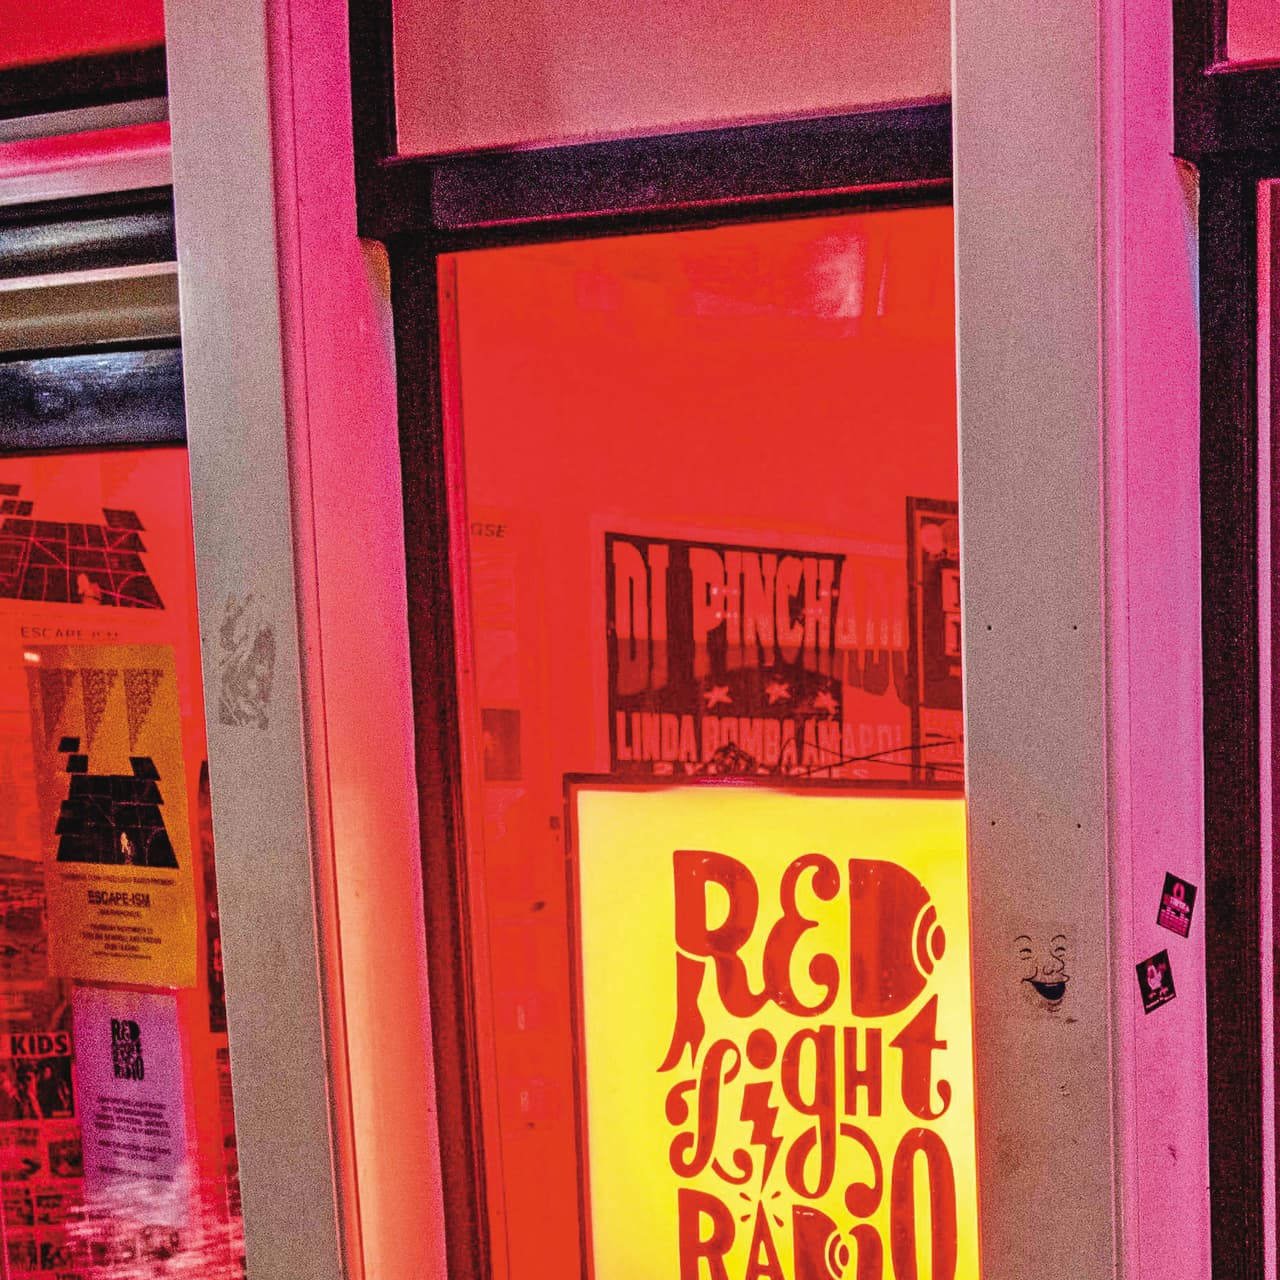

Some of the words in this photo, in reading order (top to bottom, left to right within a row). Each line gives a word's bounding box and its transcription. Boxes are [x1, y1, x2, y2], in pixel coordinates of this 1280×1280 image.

[615, 710, 698, 763] LINDA
[657, 850, 946, 1072] RED
[10, 1034, 69, 1055] KIDS
